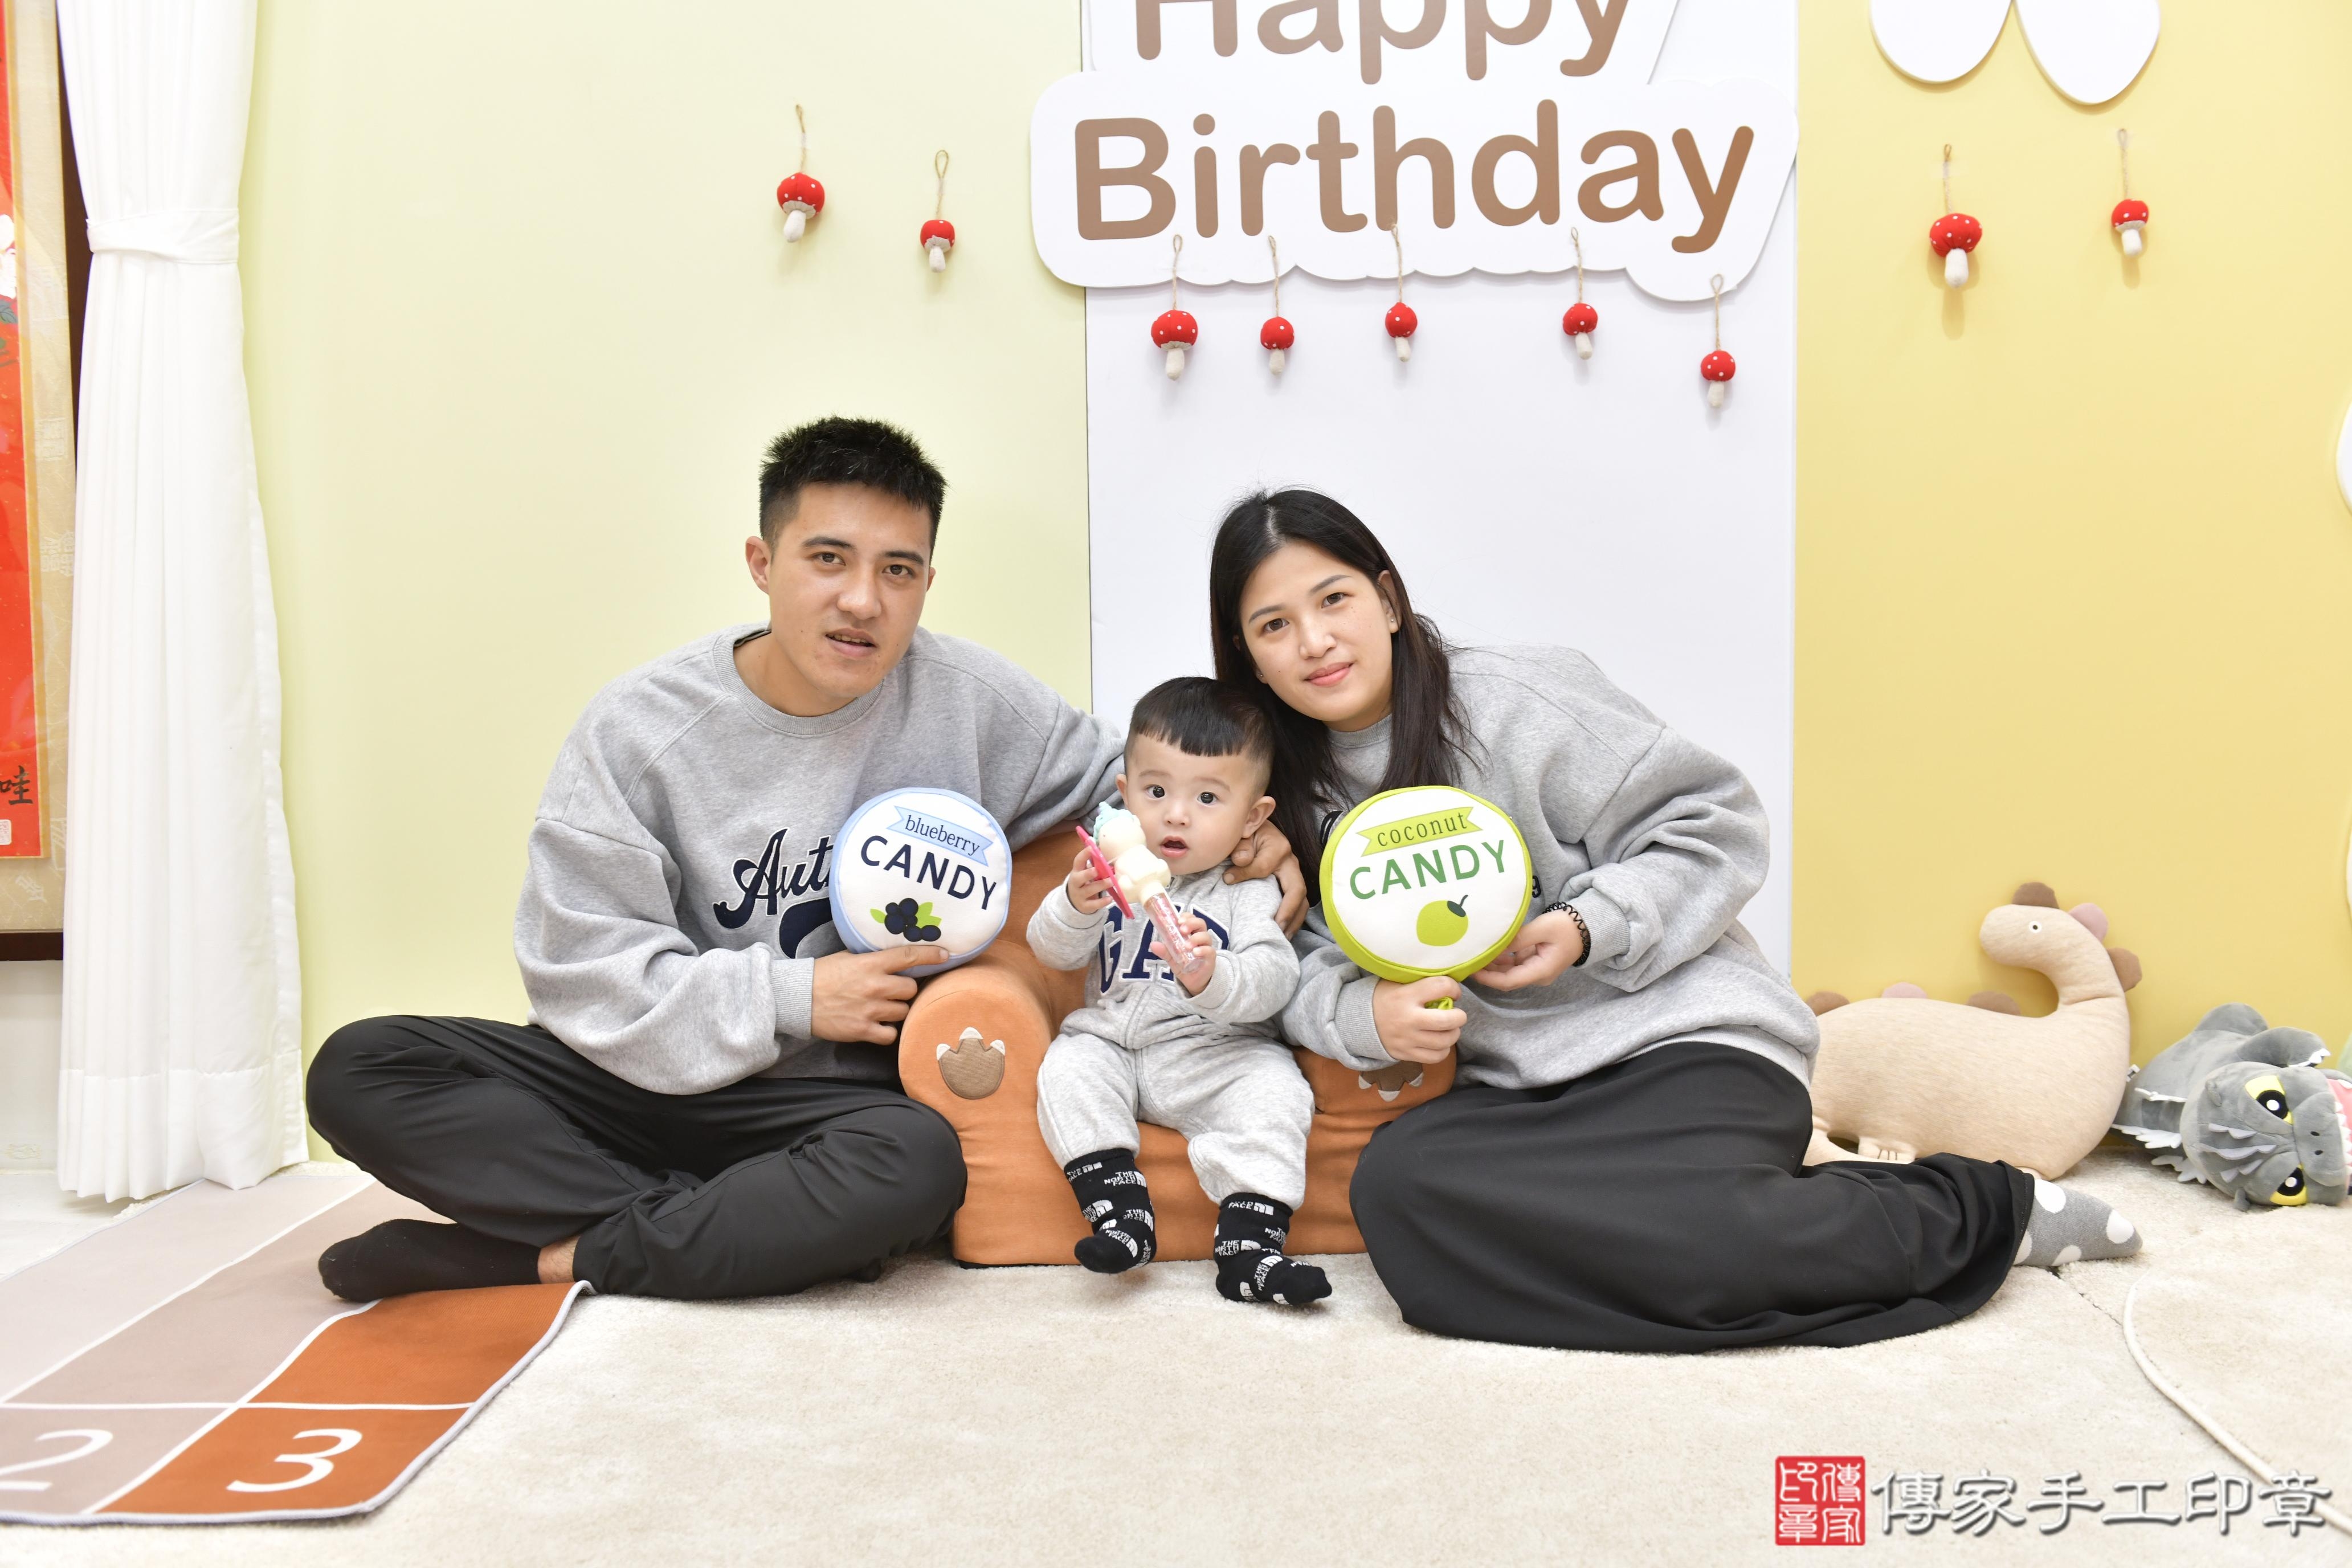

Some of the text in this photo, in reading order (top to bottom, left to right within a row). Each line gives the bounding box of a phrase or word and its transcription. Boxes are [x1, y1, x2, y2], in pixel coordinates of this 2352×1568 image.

[1136, 0, 1628, 85] Happy
[1075, 99, 1755, 254] Birthday
[904, 814, 981, 856] blueberry
[1377, 812, 1468, 847] coconut
[713, 827, 834, 929] Aut
[860, 835, 997, 911] CANDY
[1349, 839, 1505, 900] CANDY
[1104, 1175, 1136, 1185] NORTH
[0, 1428, 113, 1491] 2
[226, 1428, 363, 1492] 3
